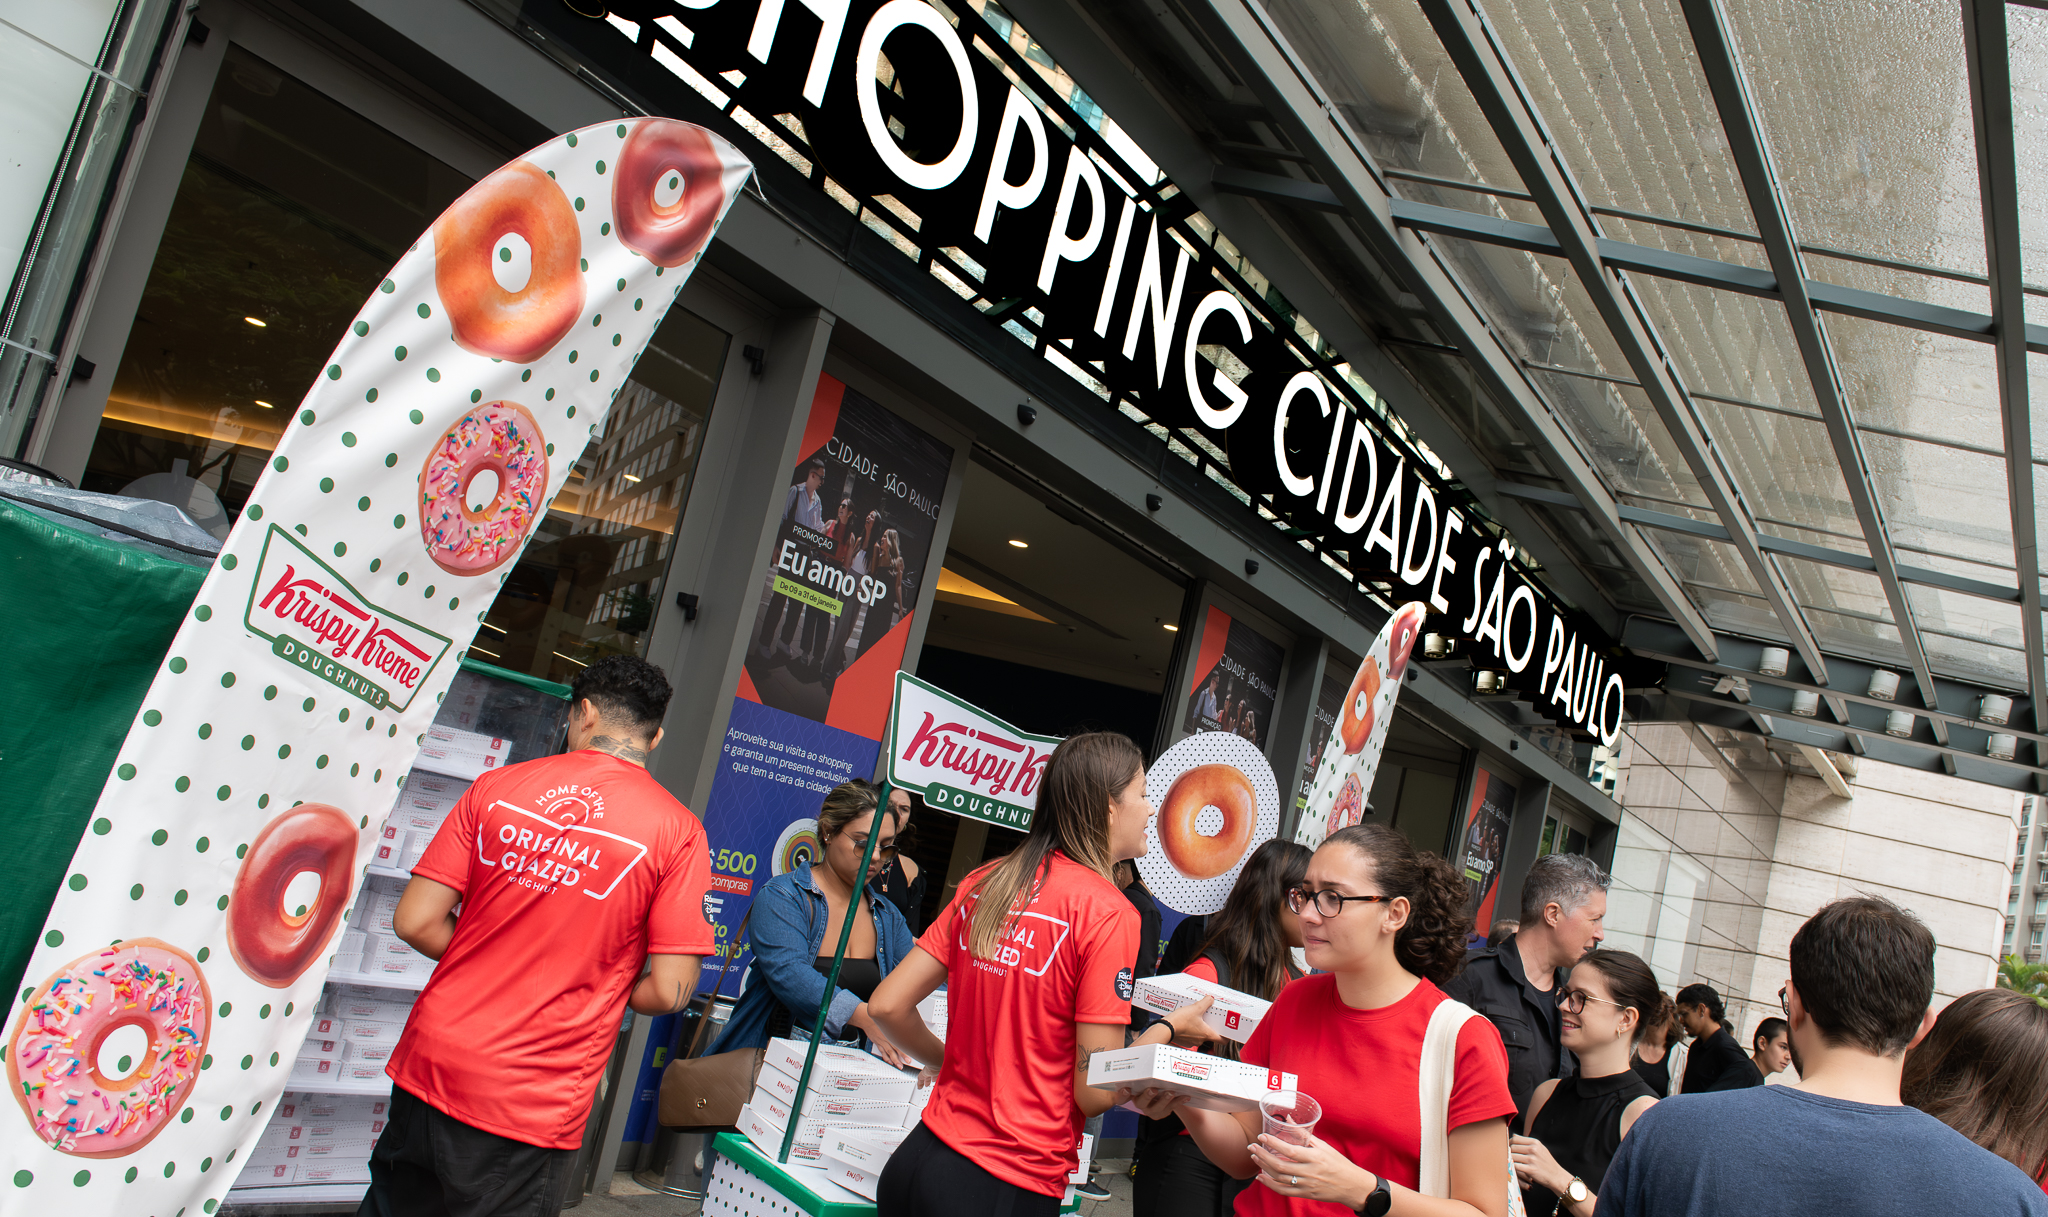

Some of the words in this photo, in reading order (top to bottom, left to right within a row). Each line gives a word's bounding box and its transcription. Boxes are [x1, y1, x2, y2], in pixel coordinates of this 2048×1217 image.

[674, 0, 1253, 429] HOPPING
[1273, 371, 1464, 614] CIDADE
[1463, 538, 1537, 673] SÃO
[1539, 614, 1624, 747] PAULO
[826, 436, 879, 481] CIDADE
[884, 473, 907, 498] SÃO
[793, 525, 833, 550] PROMOÇÃO
[778, 539, 807, 577] Eu
[808, 560, 855, 597] amo
[857, 575, 887, 607] SP
[780, 581, 789, 590] De
[789, 585, 798, 593] 09
[803, 590, 809, 598] 31
[809, 593, 817, 602] de
[817, 594, 837, 610] janeiro
[259, 564, 371, 658] Krispy
[351, 617, 432, 689] Kreme
[283, 641, 383, 705] DOUGHNUTS
[1219, 653, 1246, 679] CIDADE
[1201, 716, 1222, 731] PROMOÇÃO
[724, 744, 730, 752] e
[731, 745, 764, 762] garanta
[765, 754, 778, 766] um
[779, 759, 815, 776] presente
[815, 767, 849, 784] exclusivo
[727, 727, 768, 747] Aproveite
[769, 740, 784, 752] sua
[786, 744, 806, 757] visita
[807, 751, 817, 761] ao
[818, 752, 853, 774] shopping
[902, 711, 1026, 795] Krispy
[732, 762, 749, 775] que
[751, 765, 767, 777] tem
[768, 771, 773, 779] a
[775, 772, 793, 786] cara
[794, 775, 804, 788] da
[806, 777, 832, 795] cidade
[535, 785, 578, 806] HOME
[581, 787, 599, 799] OF
[592, 797, 605, 819] THE
[936, 788, 1031, 826] DOUGHNU
[499, 825, 601, 870] ORIGINAL
[716, 848, 757, 875] 500
[502, 852, 580, 887] GLAZED
[711, 876, 749, 891] compras
[1230, 1016, 1236, 1025] 6
[1272, 1075, 1278, 1085] 6
